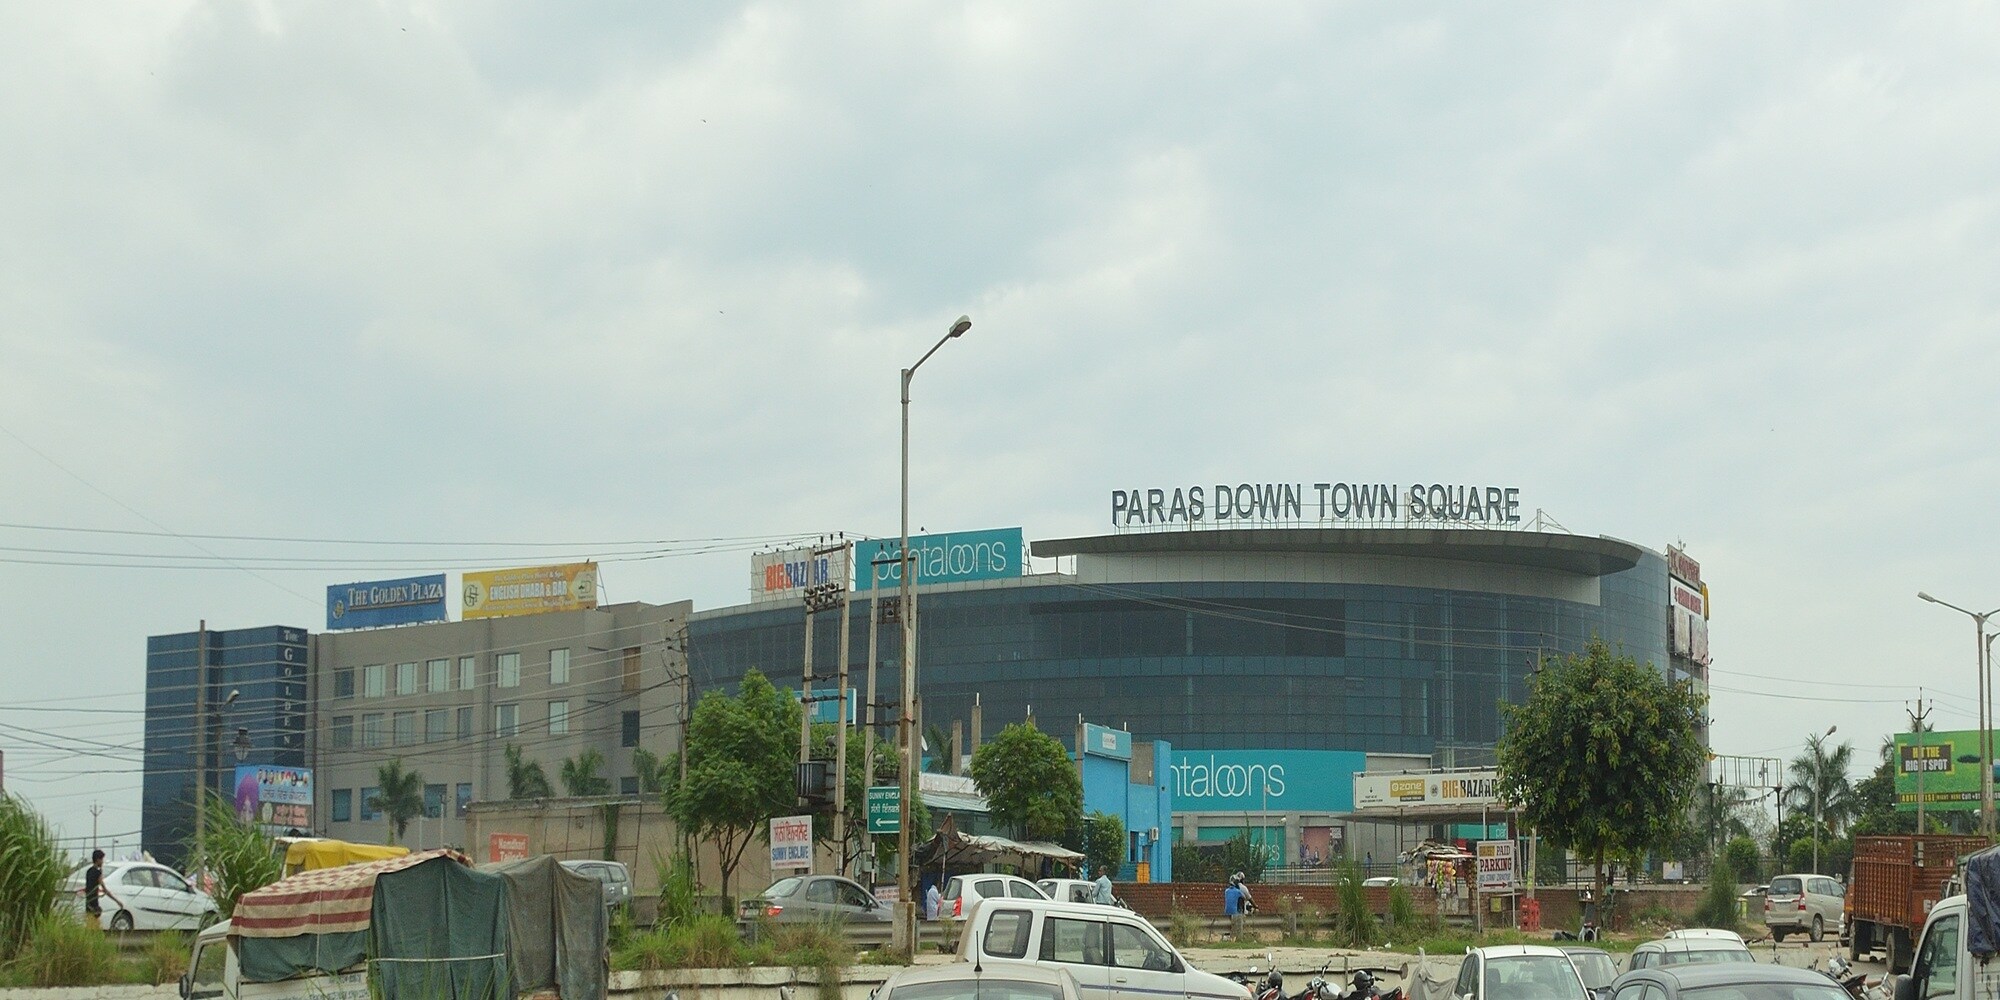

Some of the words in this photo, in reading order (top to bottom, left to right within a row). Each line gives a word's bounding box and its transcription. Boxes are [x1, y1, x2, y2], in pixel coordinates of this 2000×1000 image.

[1112, 486, 1205, 524] PARAS
[1215, 483, 1301, 519] DOWN
[1314, 482, 1398, 518] TOWN
[1410, 483, 1521, 521] SQUARE
[874, 537, 1007, 581] pantaloons
[765, 563, 784, 591] BIG
[786, 559, 828, 588] BAZAR
[348, 588, 368, 606] THE
[370, 585, 408, 604] GOLDEN
[411, 581, 444, 600] PLAZA
[490, 584, 520, 600] ENGLISH
[545, 582, 551, 596] &
[552, 580, 567, 596] BAR
[1912, 747, 1925, 758] HT
[1926, 746, 1940, 757] THE
[1905, 760, 1928, 771] RIGT
[1929, 759, 1948, 770] SPOT
[1170, 754, 1285, 797] ntaloons
[1442, 780, 1459, 798] BIG
[772, 847, 787, 861] SUNNY
[788, 846, 809, 859] ENCLAVE
[1496, 845, 1511, 856] PAID
[1480, 857, 1512, 872] PARKING
